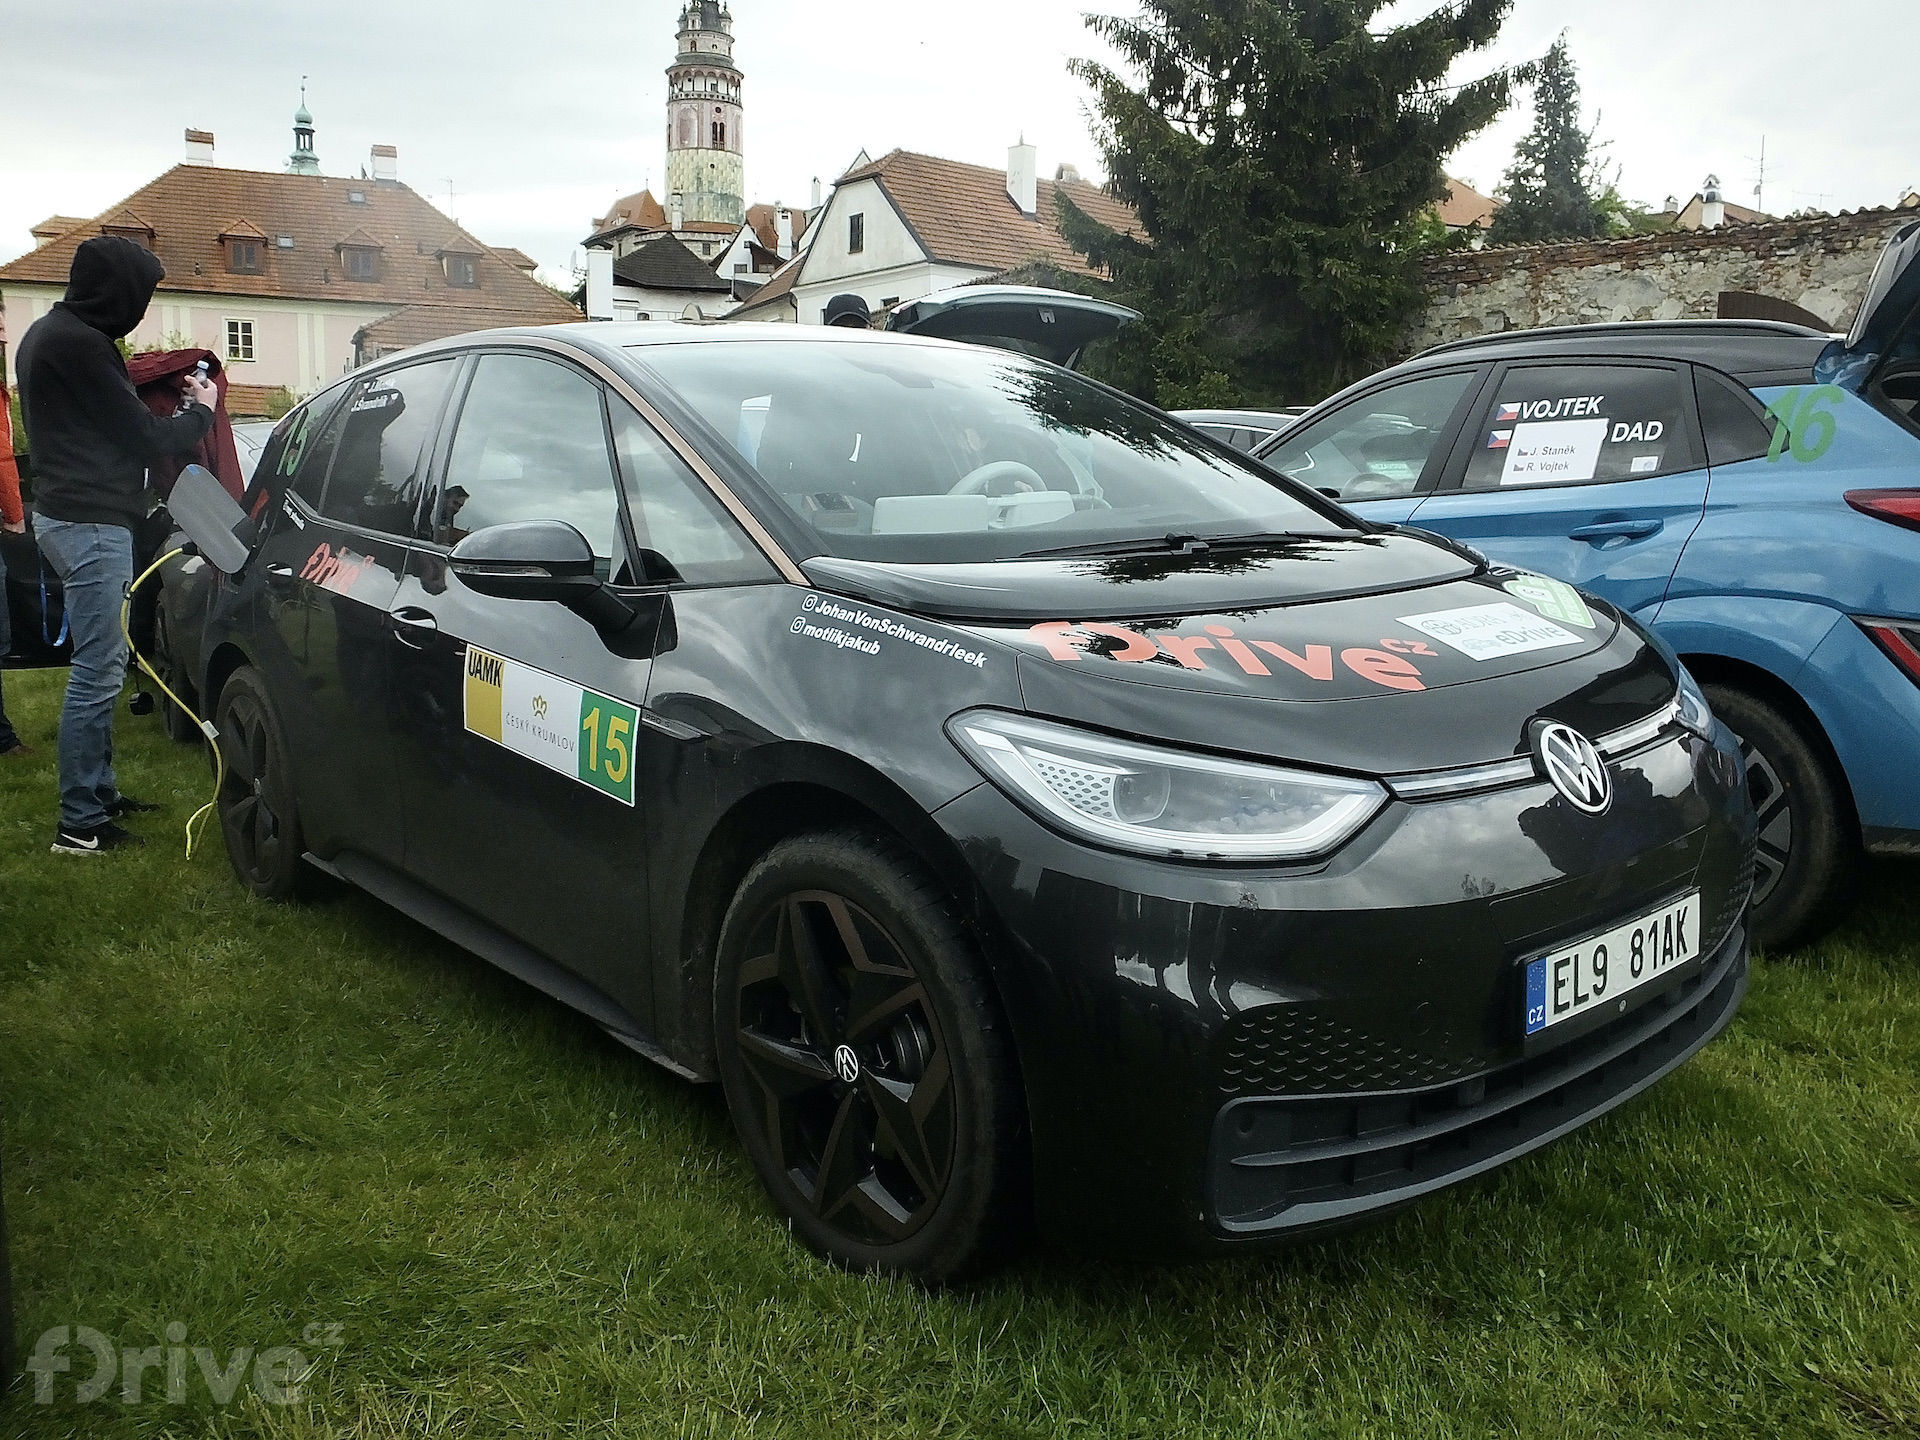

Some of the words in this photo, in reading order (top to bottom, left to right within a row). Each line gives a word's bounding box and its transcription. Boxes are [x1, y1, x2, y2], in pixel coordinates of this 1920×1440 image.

[1521, 396, 1604, 419] VOJTEK
[1611, 421, 1664, 442] DAD
[1765, 385, 1845, 463] 16
[1530, 447, 1538, 456] J.
[1539, 461, 1570, 472] Vojtek
[645, 713, 662, 725] PRO
[532, 725, 575, 753] KRUMLOV
[583, 707, 630, 783] 15
[1554, 943, 1608, 1015] EL9
[1630, 906, 1689, 979] 81AK
[1528, 1005, 1544, 1026] CZ
